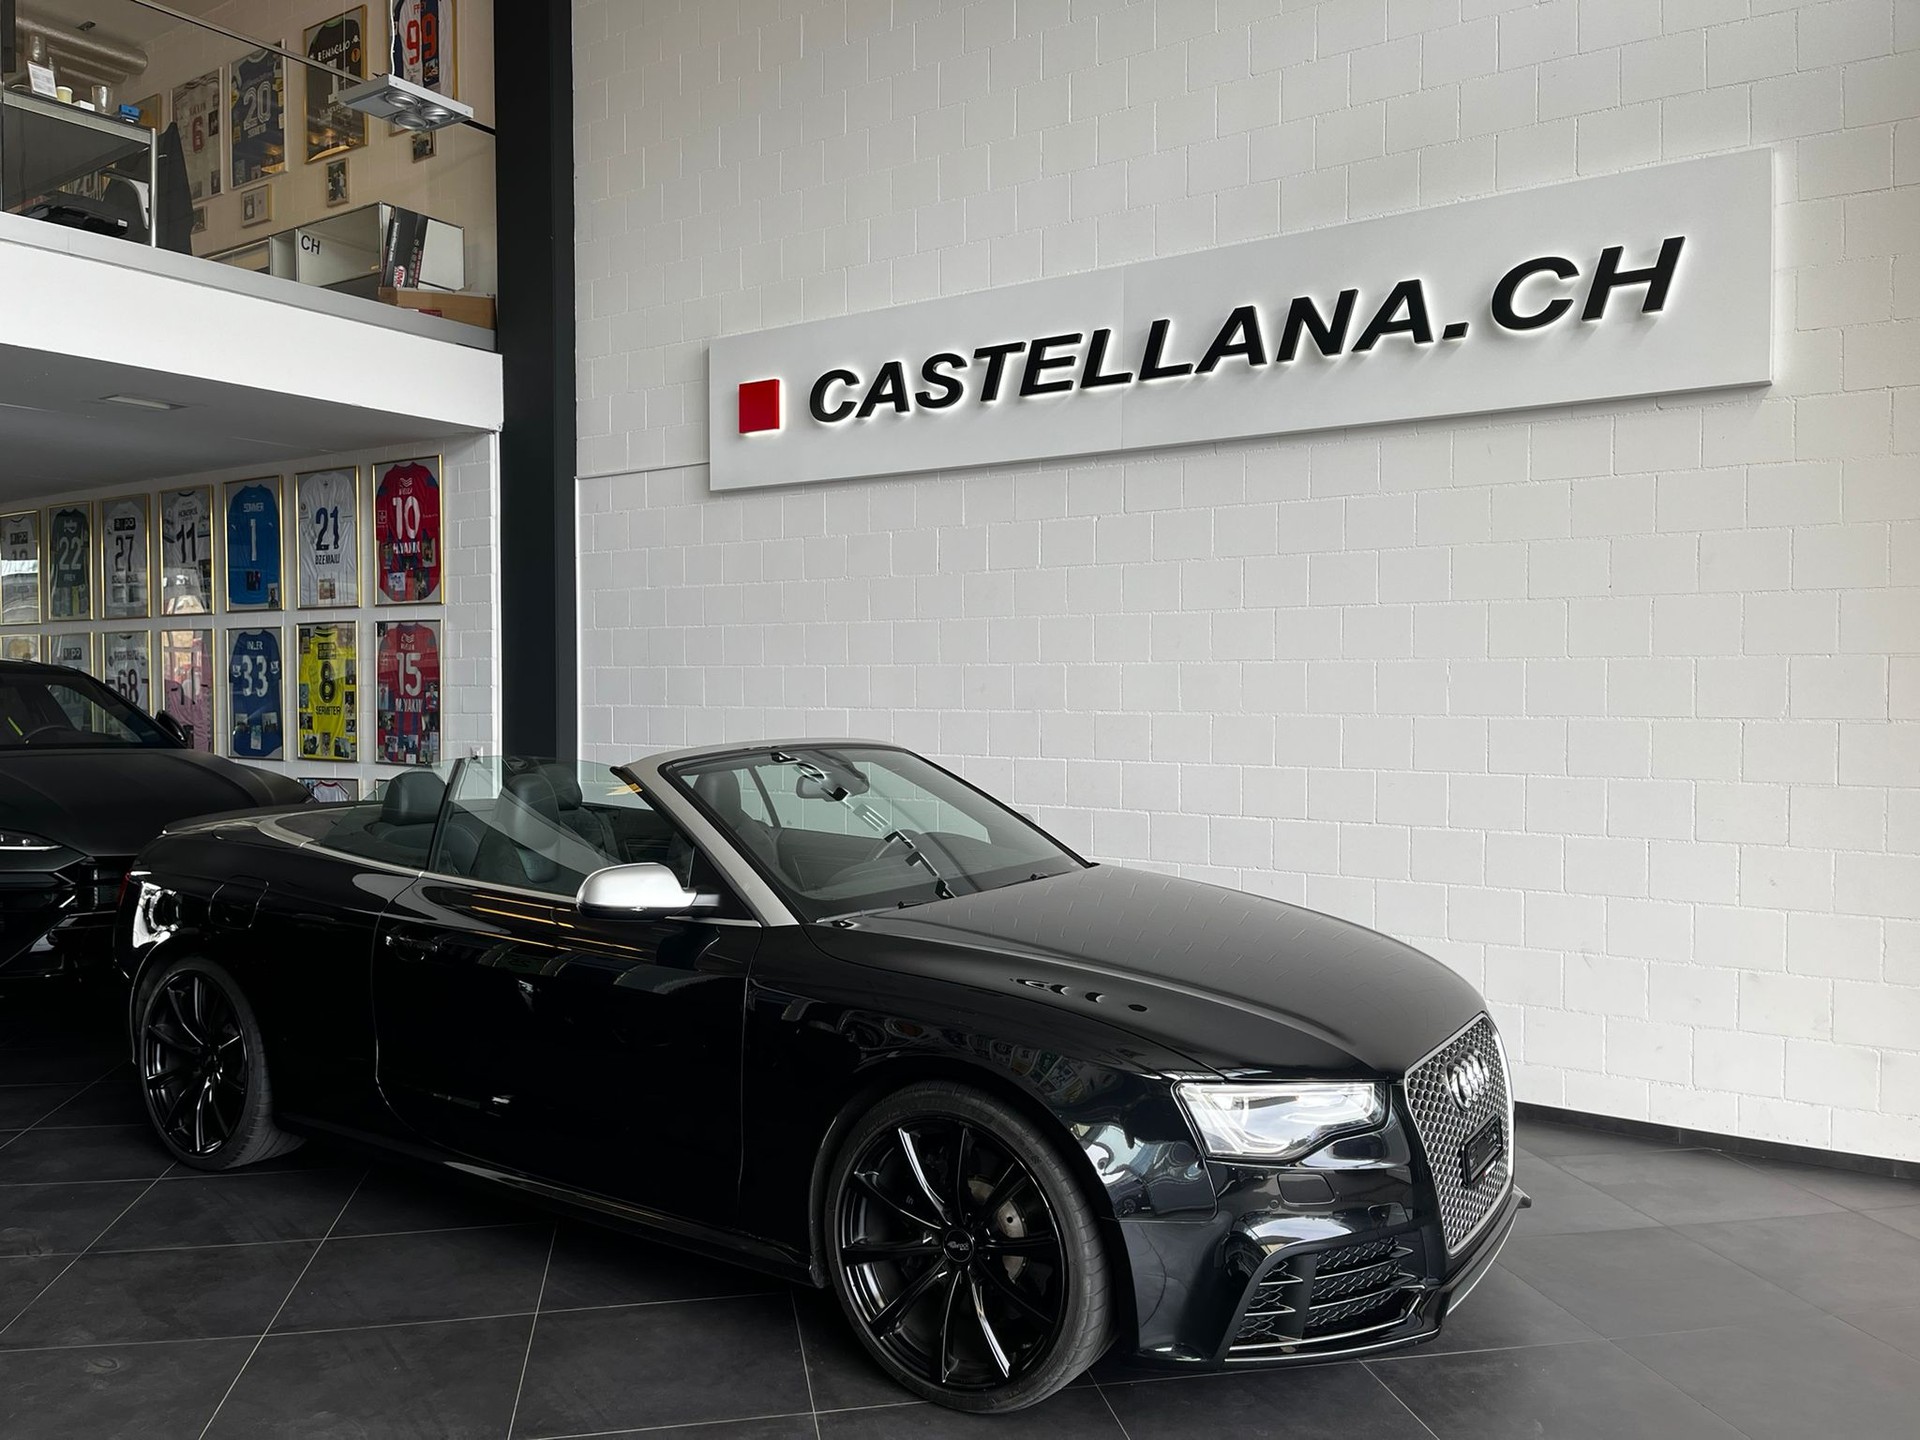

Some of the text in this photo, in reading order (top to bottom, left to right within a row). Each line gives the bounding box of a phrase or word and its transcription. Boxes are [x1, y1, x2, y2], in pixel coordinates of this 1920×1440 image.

[243, 81, 271, 130] 20
[300, 235, 321, 255] CH
[809, 235, 1686, 424] CASTELLANA.CH
[315, 506, 340, 551] 21
[393, 496, 421, 539] 10
[60, 536, 82, 570] 22
[115, 534, 134, 572] 27
[176, 522, 196, 563] 11
[250, 519, 257, 561] 1
[242, 655, 269, 698] 33
[319, 660, 336, 703] 8
[396, 652, 422, 697] 15
